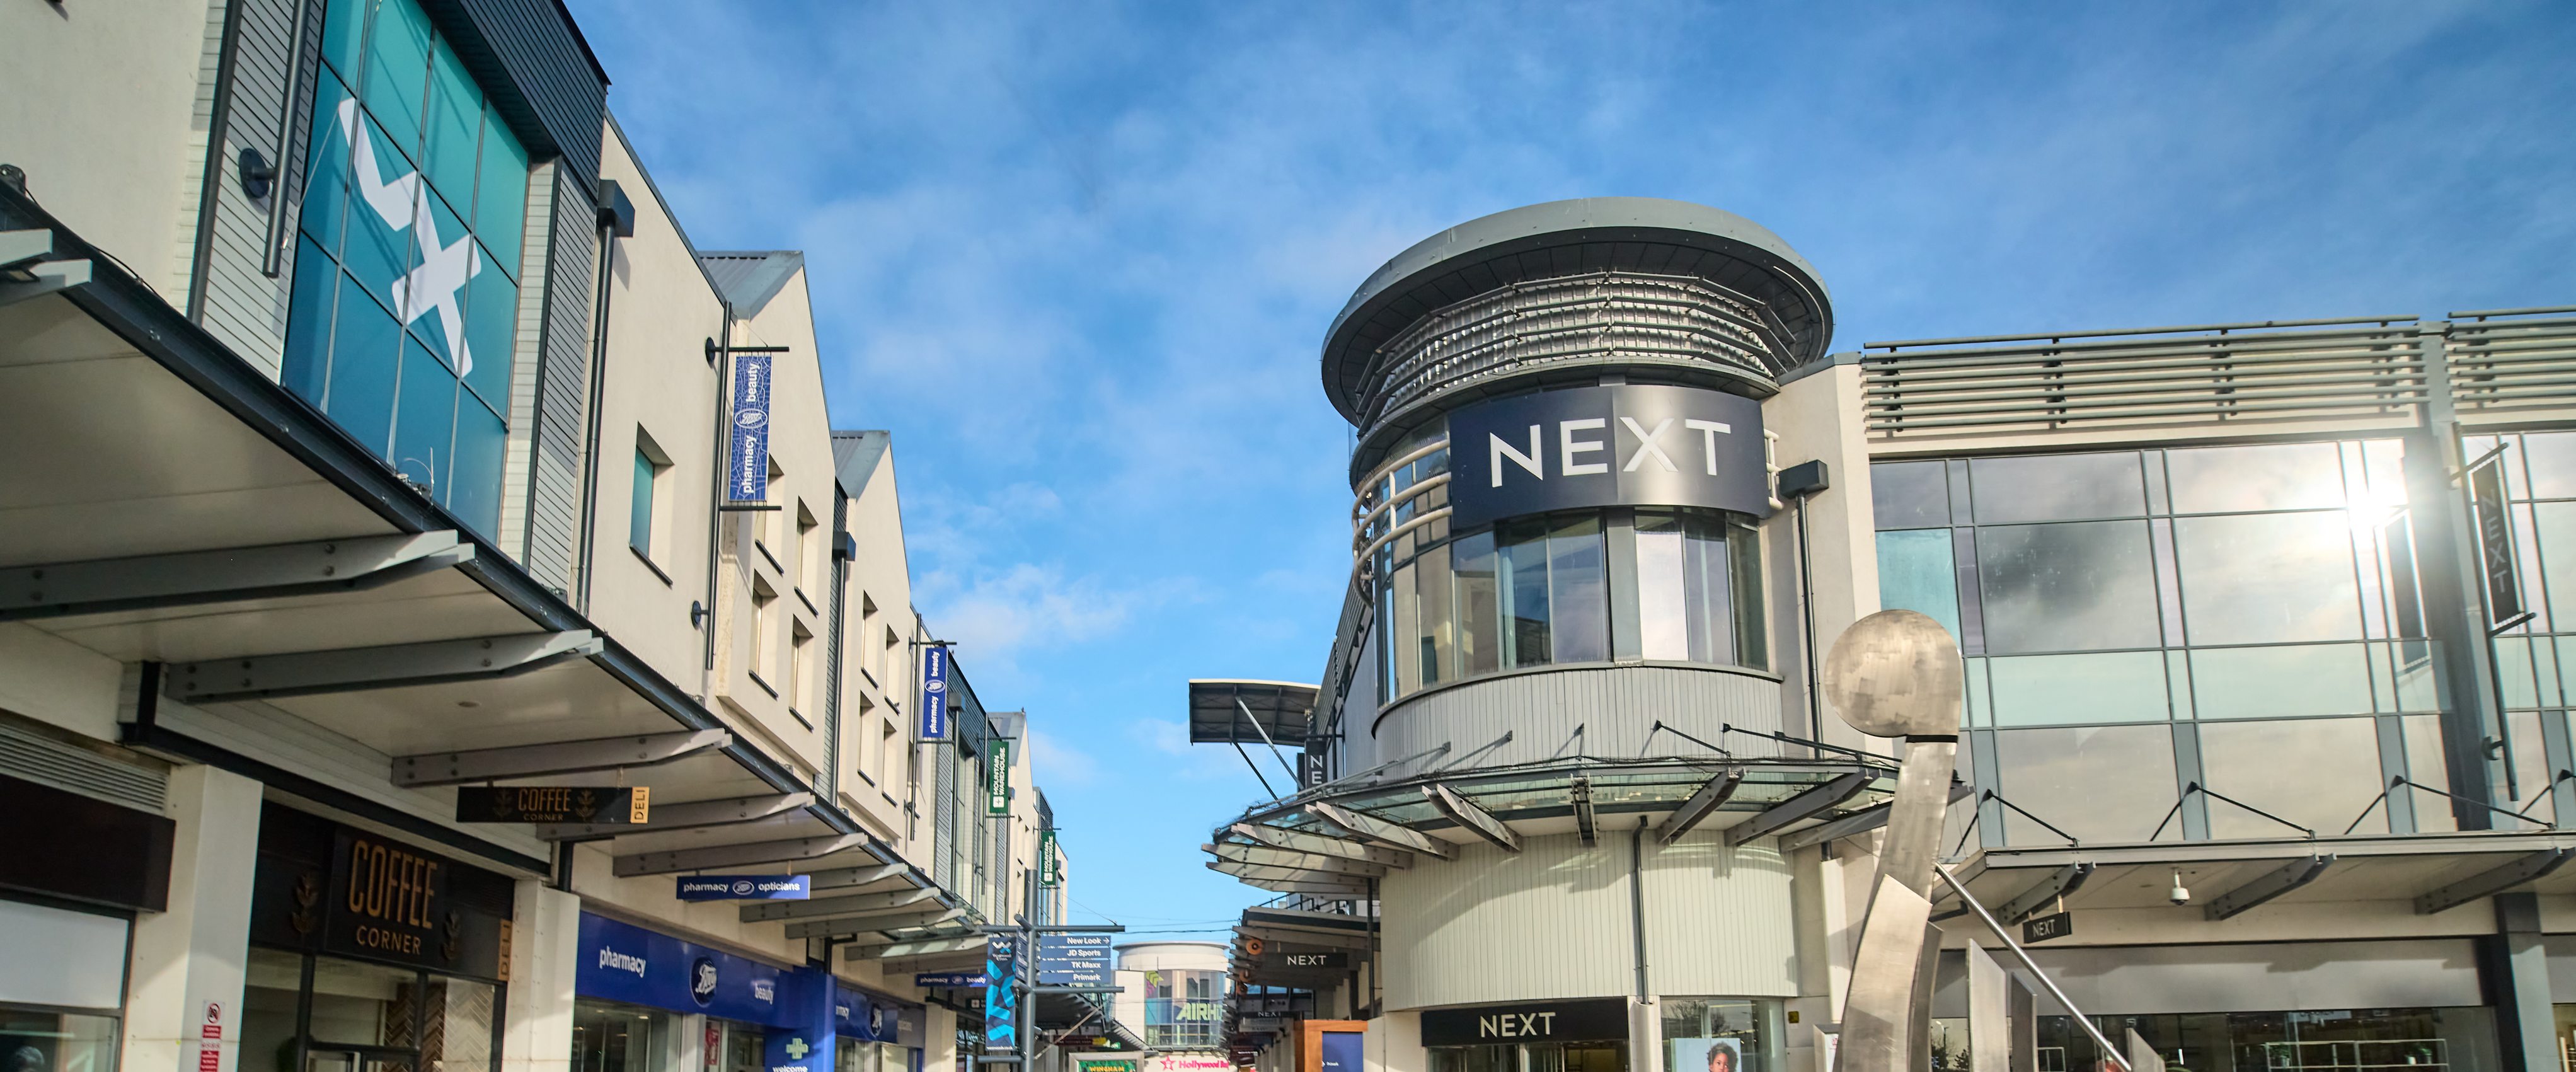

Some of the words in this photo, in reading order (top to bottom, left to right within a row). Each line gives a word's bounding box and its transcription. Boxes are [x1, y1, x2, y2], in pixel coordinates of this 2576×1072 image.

[746, 363, 760, 402] beauty
[742, 435, 756, 493] pharmacy
[1490, 417, 1731, 488] NEXT
[2480, 488, 2507, 593] NEXT
[931, 651, 940, 677] beauty
[929, 696, 939, 734] pharmacy
[1311, 755, 1323, 784] NE
[518, 788, 570, 811] COFFEE
[635, 790, 645, 821] DELI
[524, 812, 564, 821] CORNER
[349, 840, 437, 929] COFFEE
[684, 882, 728, 892] pharmacy
[758, 882, 800, 892] opticians
[357, 925, 421, 955] CORNER
[2032, 919, 2055, 937] NEXT
[501, 925, 510, 975] DELI
[599, 946, 646, 978] pharmacy
[1078, 950, 1101, 958] Sports
[1287, 955, 1326, 965] NEXT
[967, 976, 986, 984] beauty
[755, 983, 774, 1005] beauty
[1480, 1012, 1556, 1037] NEXT
[1179, 1059, 1219, 1070] Hollywood
